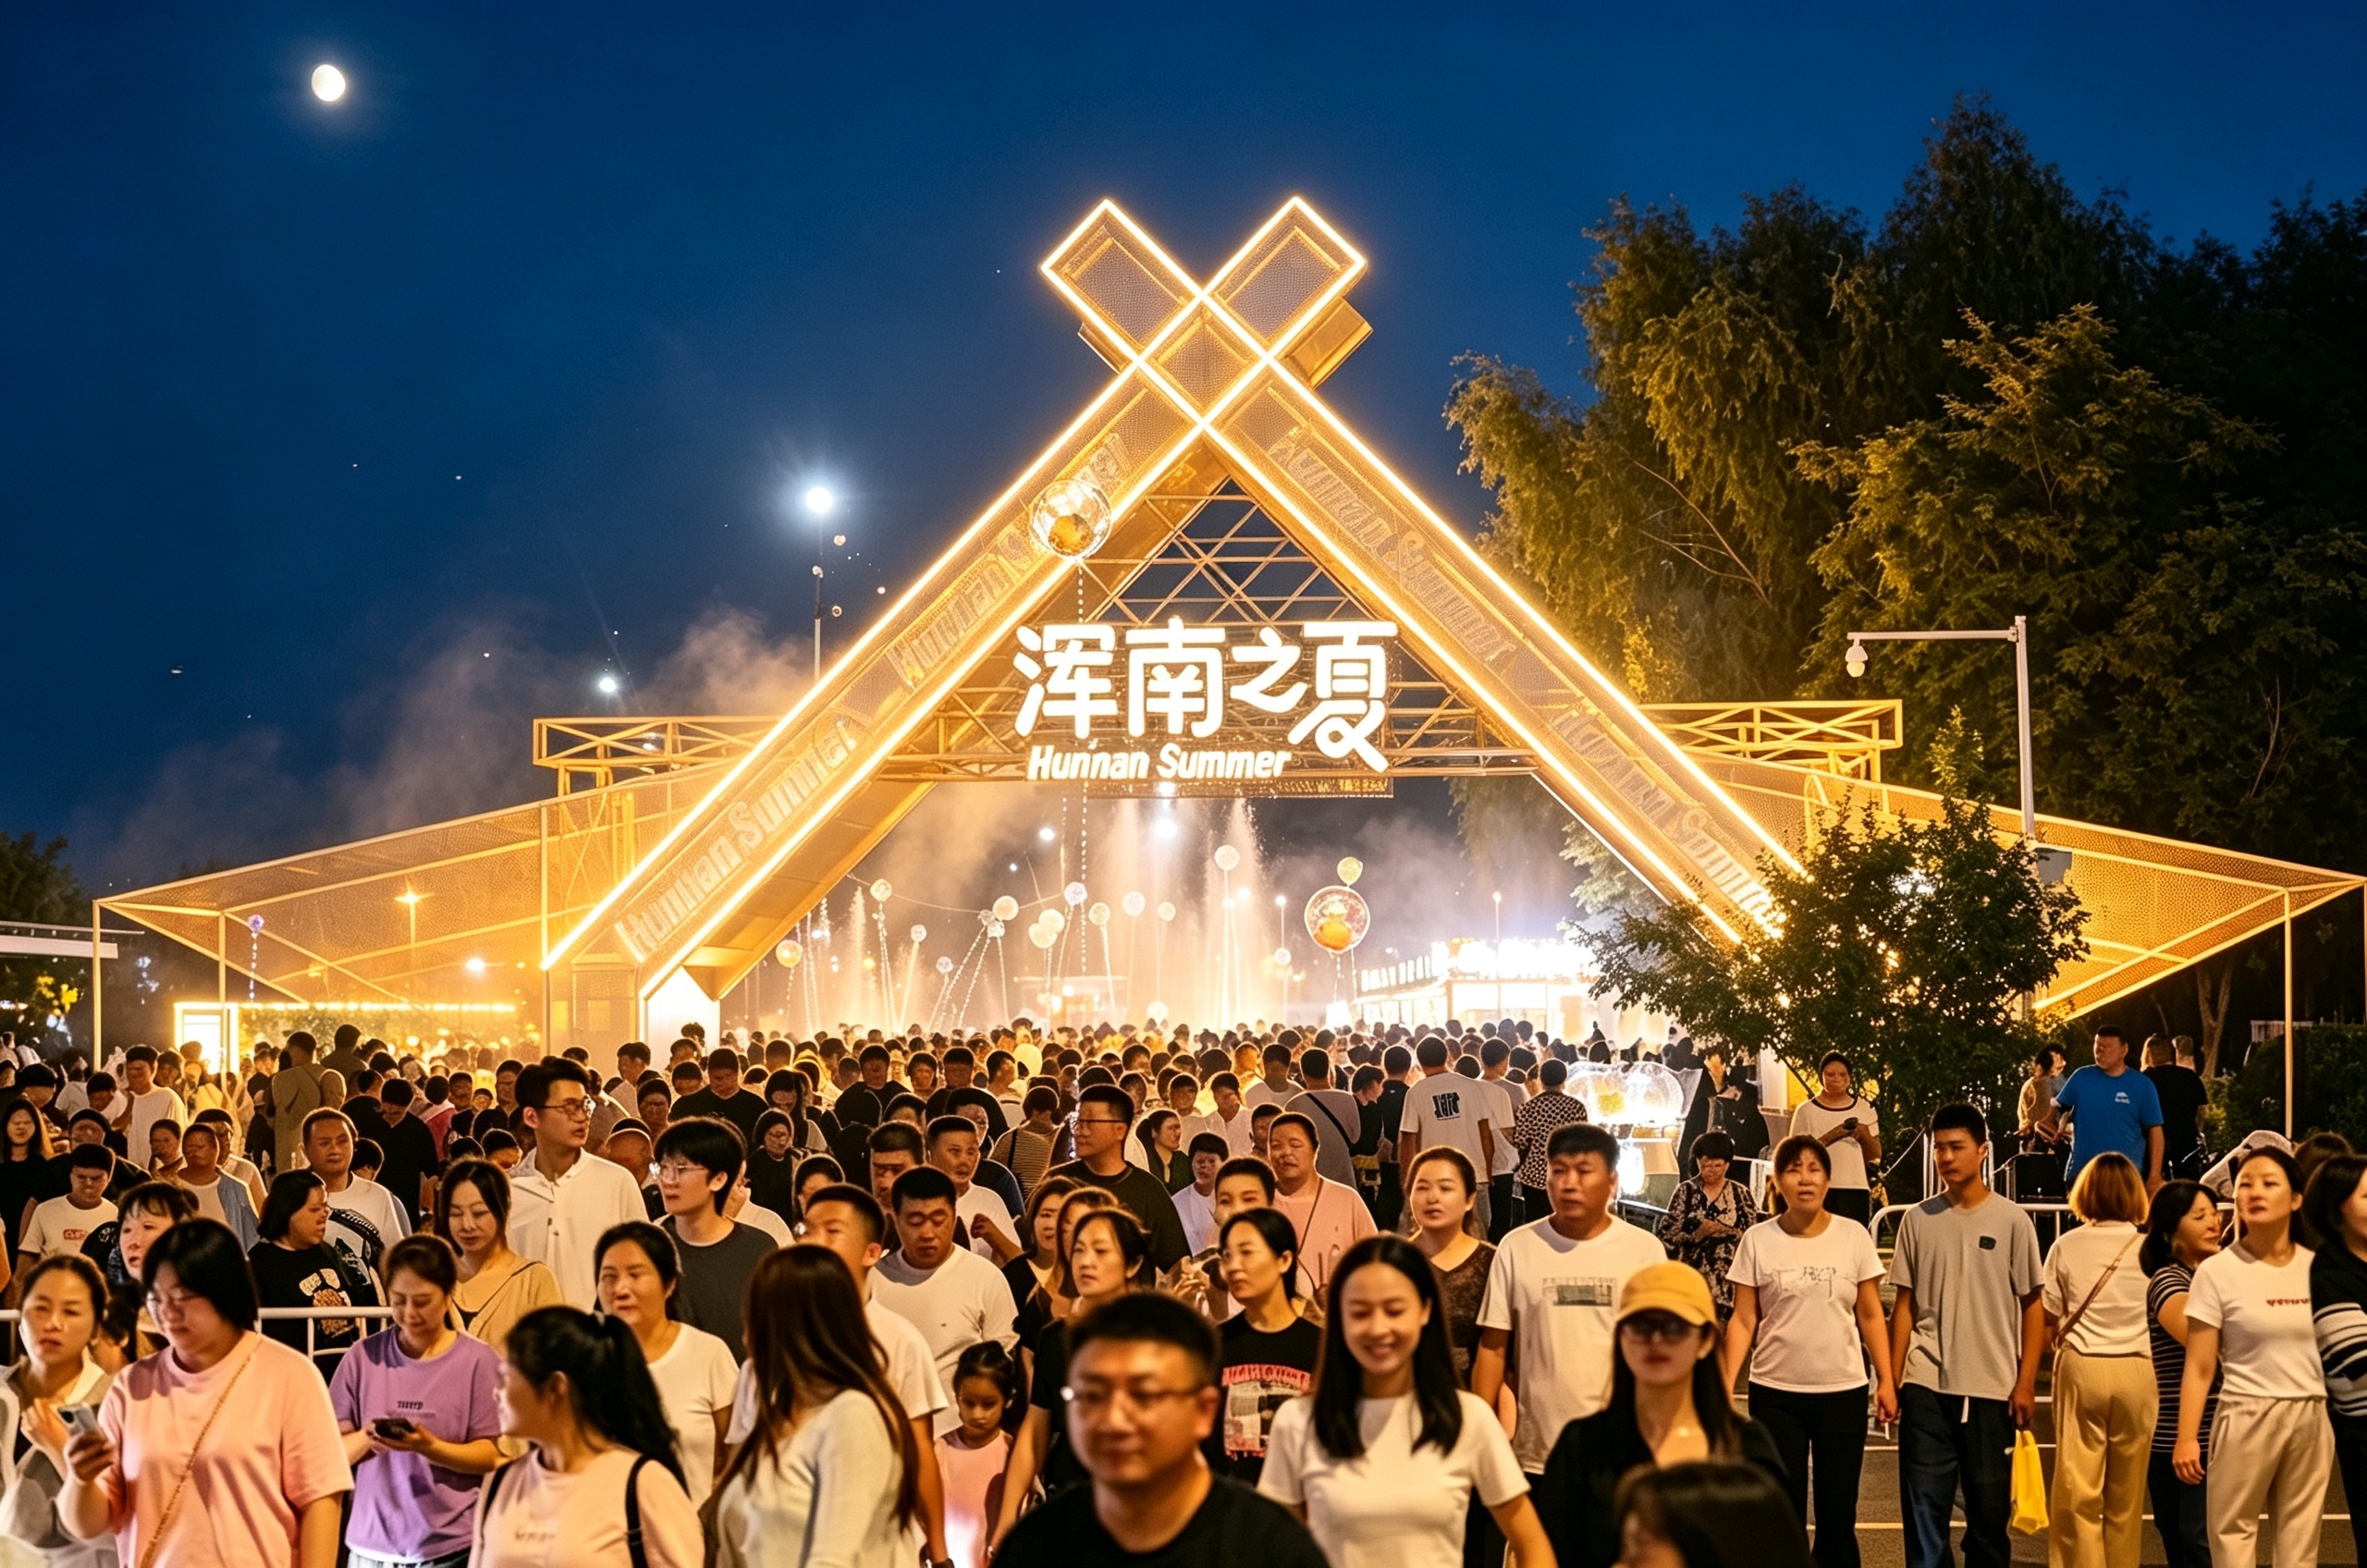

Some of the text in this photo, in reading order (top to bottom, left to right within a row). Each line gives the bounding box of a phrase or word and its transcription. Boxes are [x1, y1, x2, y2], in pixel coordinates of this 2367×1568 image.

[1013, 617, 1398, 772] 浑南之夏
[1028, 743, 1292, 780] Hunnan Summer
